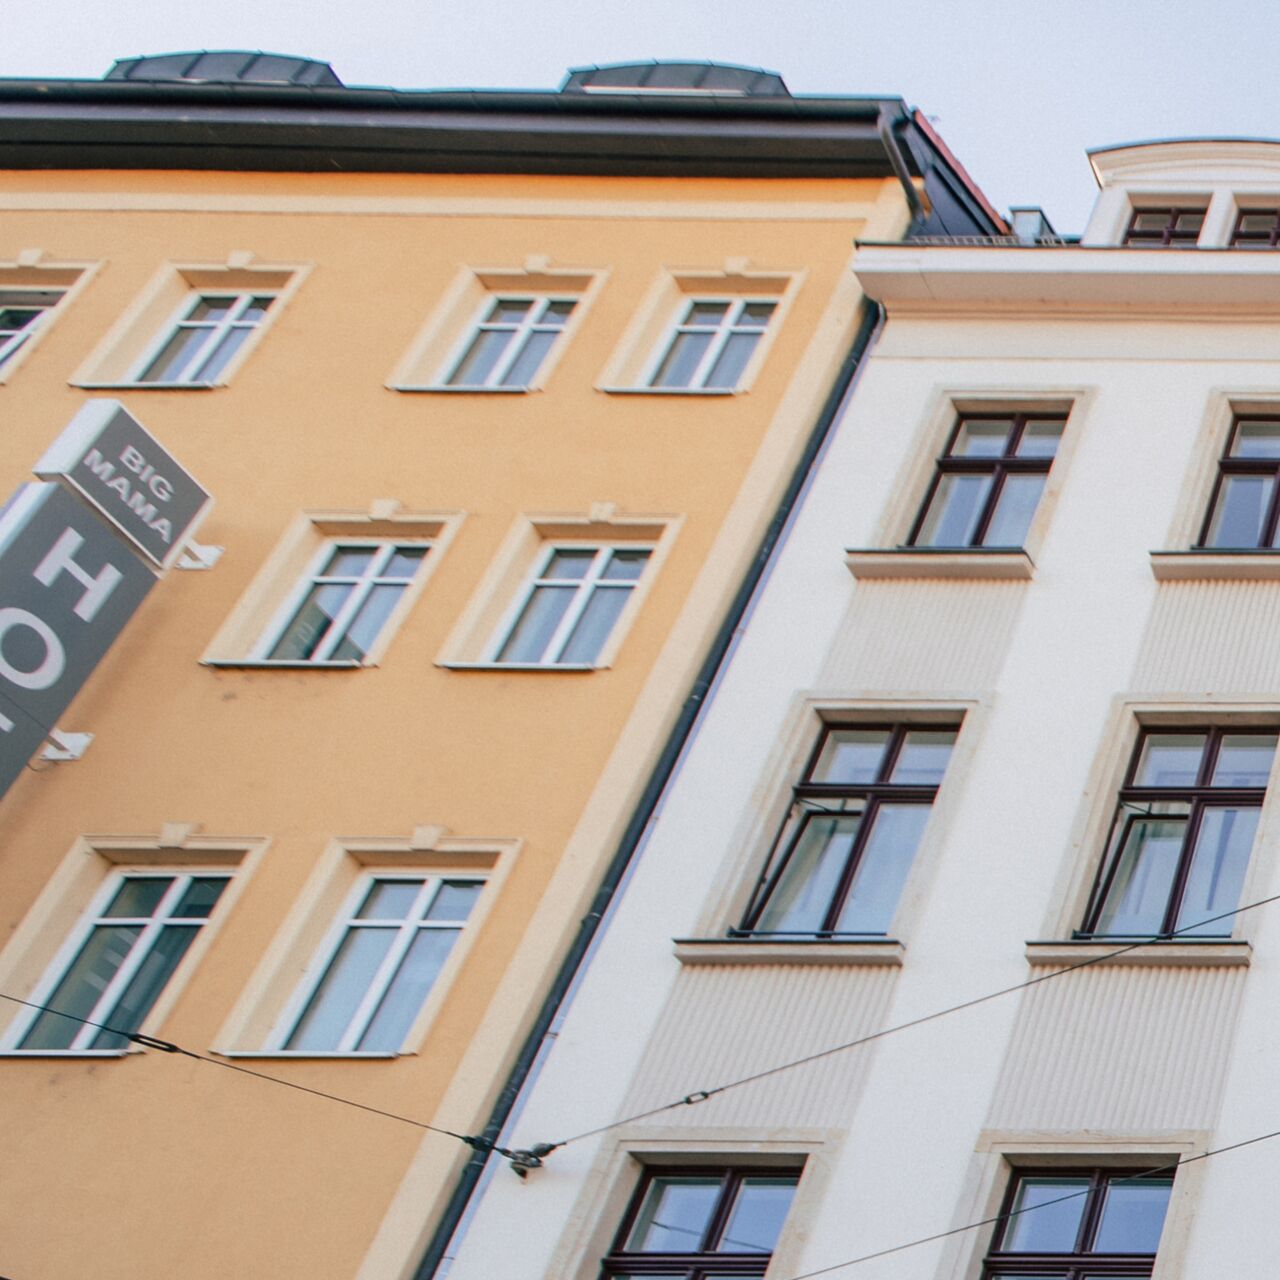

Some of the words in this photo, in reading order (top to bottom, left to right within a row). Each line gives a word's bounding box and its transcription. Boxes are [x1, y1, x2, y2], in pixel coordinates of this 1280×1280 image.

[83, 448, 174, 544] MAMA
[119, 445, 175, 502] BIG
[0, 526, 124, 733] HO
